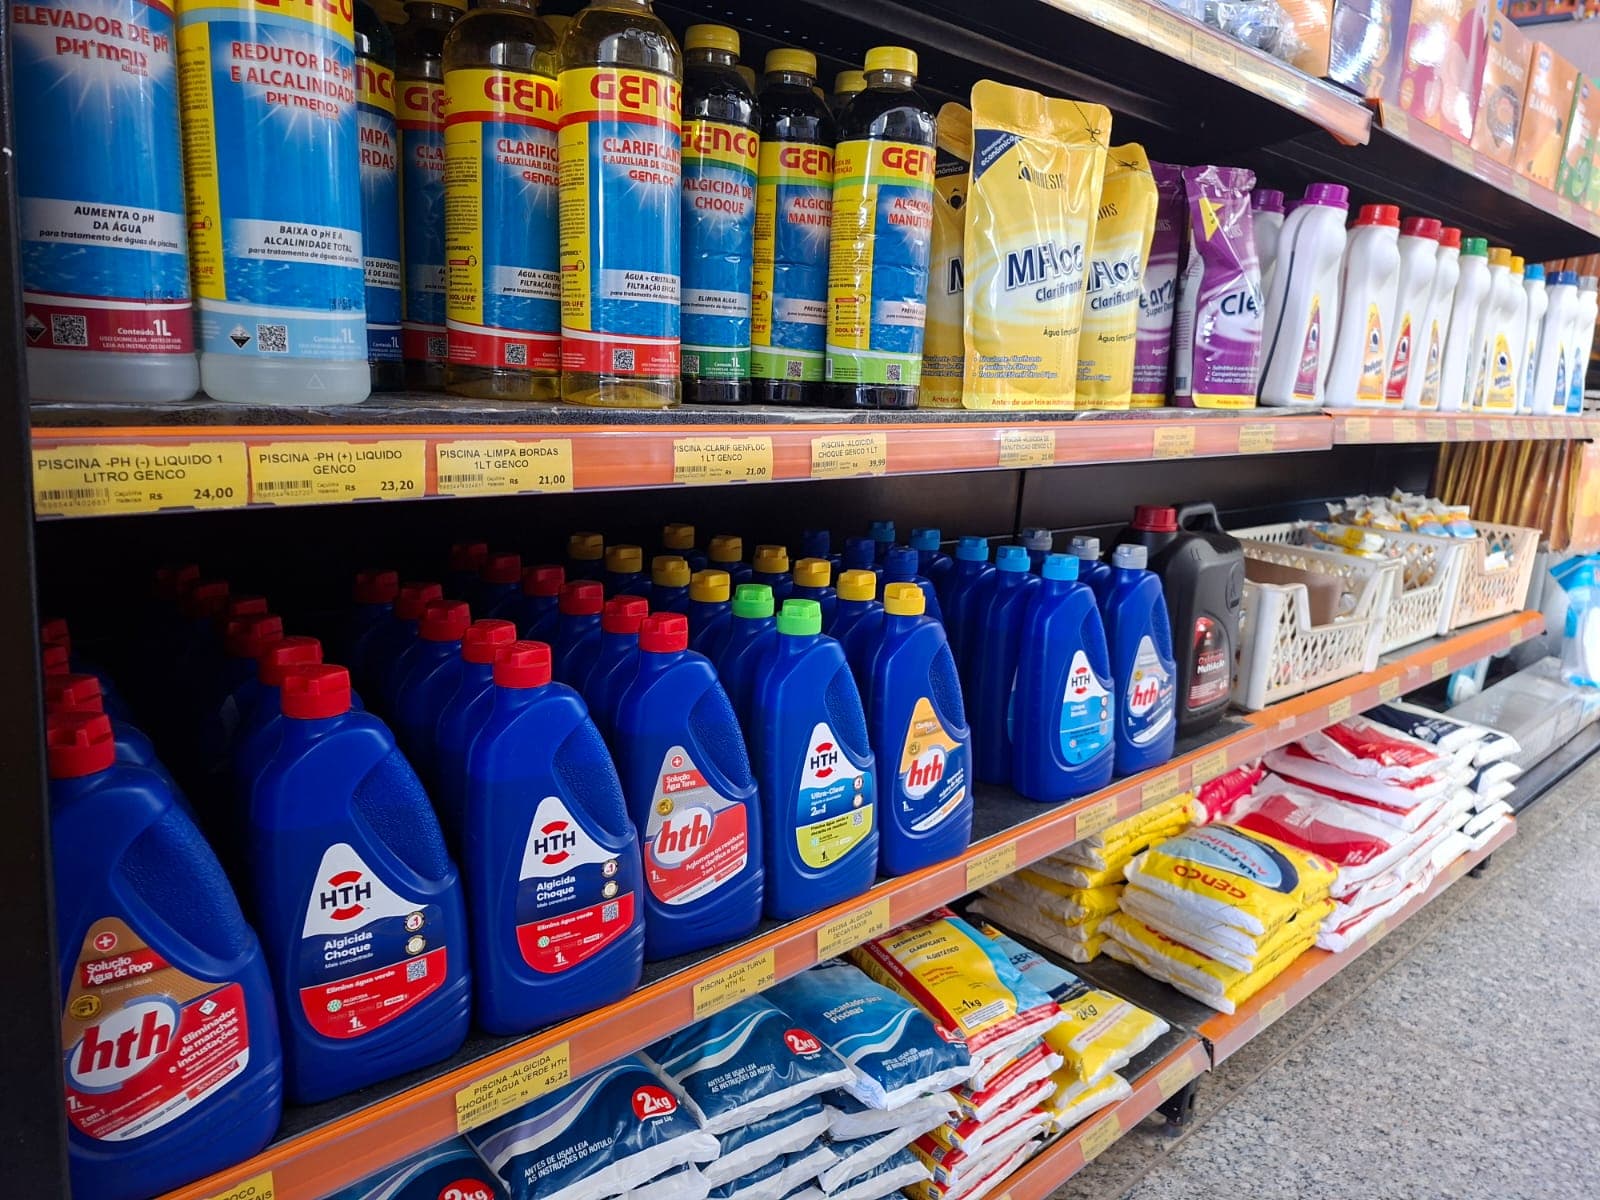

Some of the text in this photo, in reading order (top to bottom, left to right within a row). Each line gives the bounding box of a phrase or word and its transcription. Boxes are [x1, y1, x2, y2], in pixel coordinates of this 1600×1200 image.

[12, 5, 169, 53] ELEVADOR DE pH
[231, 41, 318, 71] REDUTOR
[323, 57, 340, 76] DE
[360, 126, 390, 152] MPA
[361, 149, 395, 170] RDAS
[504, 156, 552, 171] AUXILIAR DE
[611, 156, 660, 170] AUXILIAR DE
[684, 178, 752, 200] ALGICIDA DE
[695, 196, 744, 214] CHOQUE
[74, 206, 155, 224] AUMENTA pH
[93, 221, 142, 234] DA ÁGUA
[280, 225, 330, 239] BAIXA pH
[61, 231, 111, 242] tratamento
[124, 236, 147, 246] águas
[149, 238, 157, 246] de
[264, 236, 352, 253] ALCALINIDADE TOTAL
[267, 249, 309, 257] tratamento
[517, 269, 538, 279] ÁGUA
[1007, 241, 1083, 290] MFloc
[520, 278, 551, 291] FILTRAÇÃO
[625, 271, 643, 282] ÁGUA
[626, 282, 658, 293] FILTRAÇÃO
[117, 319, 171, 337] Conteúdo 1L
[341, 327, 355, 344] 1L
[1043, 326, 1060, 337] Água
[391, 336, 399, 348] 1L
[668, 351, 676, 363] 1L
[731, 356, 741, 369] 1L
[259, 450, 403, 463] PISCINA -PH (+) LIQUIDO
[440, 448, 559, 458] PISCINA -LIMPA BORDAS
[674, 444, 701, 453] PISCINA
[732, 443, 765, 452] GENFLOC
[818, 450, 844, 458] CHOQUE
[38, 454, 212, 470] PISCINA -PH (-) LIQUIDO
[475, 460, 528, 469] 1LT GENCO
[717, 454, 743, 462] GENCO
[84, 469, 186, 483] LITRO GENCO
[313, 464, 356, 475] GENCO
[746, 467, 766, 475] 21,00
[380, 480, 414, 492] 23,20
[539, 475, 566, 485] 21,00
[193, 487, 234, 501] 24,00
[1071, 675, 1091, 688] HTH
[1132, 682, 1158, 707] hth
[810, 751, 838, 769] HTH
[666, 773, 690, 782] Solução
[908, 754, 943, 788] hth
[657, 814, 709, 854] hth
[534, 831, 576, 855] HTH
[686, 851, 715, 871] Aglomera
[536, 876, 576, 892] Algicida
[1173, 864, 1247, 899] GENCO
[320, 881, 371, 910] HTH
[537, 886, 574, 901] Choque
[537, 911, 593, 931] Elimina água verde
[324, 931, 373, 951] Algicida
[892, 929, 932, 949] DESINFETANTE
[908, 936, 948, 954] CLARIFICANTE
[324, 943, 371, 961] Choque
[555, 952, 566, 963] 1L
[87, 957, 132, 974] Solução
[88, 961, 153, 985] Água de Poço
[326, 970, 395, 994] Elimina água verde
[700, 958, 767, 992] PISCINA TURVA
[724, 979, 737, 990] HTH
[823, 996, 865, 1018] Decantador
[962, 998, 983, 1010] 1kg
[349, 1016, 363, 1029] 1L
[830, 1005, 864, 1024] Piscinas
[182, 1007, 237, 1044] Eliminador
[77, 1010, 171, 1075] hth
[179, 1016, 238, 1057] de manchas
[787, 1034, 816, 1052] 2kg
[177, 1026, 238, 1068] incrustações
[474, 1055, 551, 1096] PISCINA -ALGICIDA
[544, 1070, 569, 1086] 45,22
[708, 1075, 725, 1088] ANTES
[725, 1073, 732, 1081] DE
[457, 1056, 567, 1114] CHOQUE AGUA VERDE HTH
[67, 1095, 83, 1109] 1L
[637, 1091, 672, 1114] 2kg
[524, 1140, 589, 1178] ANTES DE USAR LEIA
[528, 1174, 538, 1185] AS
[538, 1156, 578, 1181] INSTRUÇÕES
[578, 1149, 588, 1162] DO
